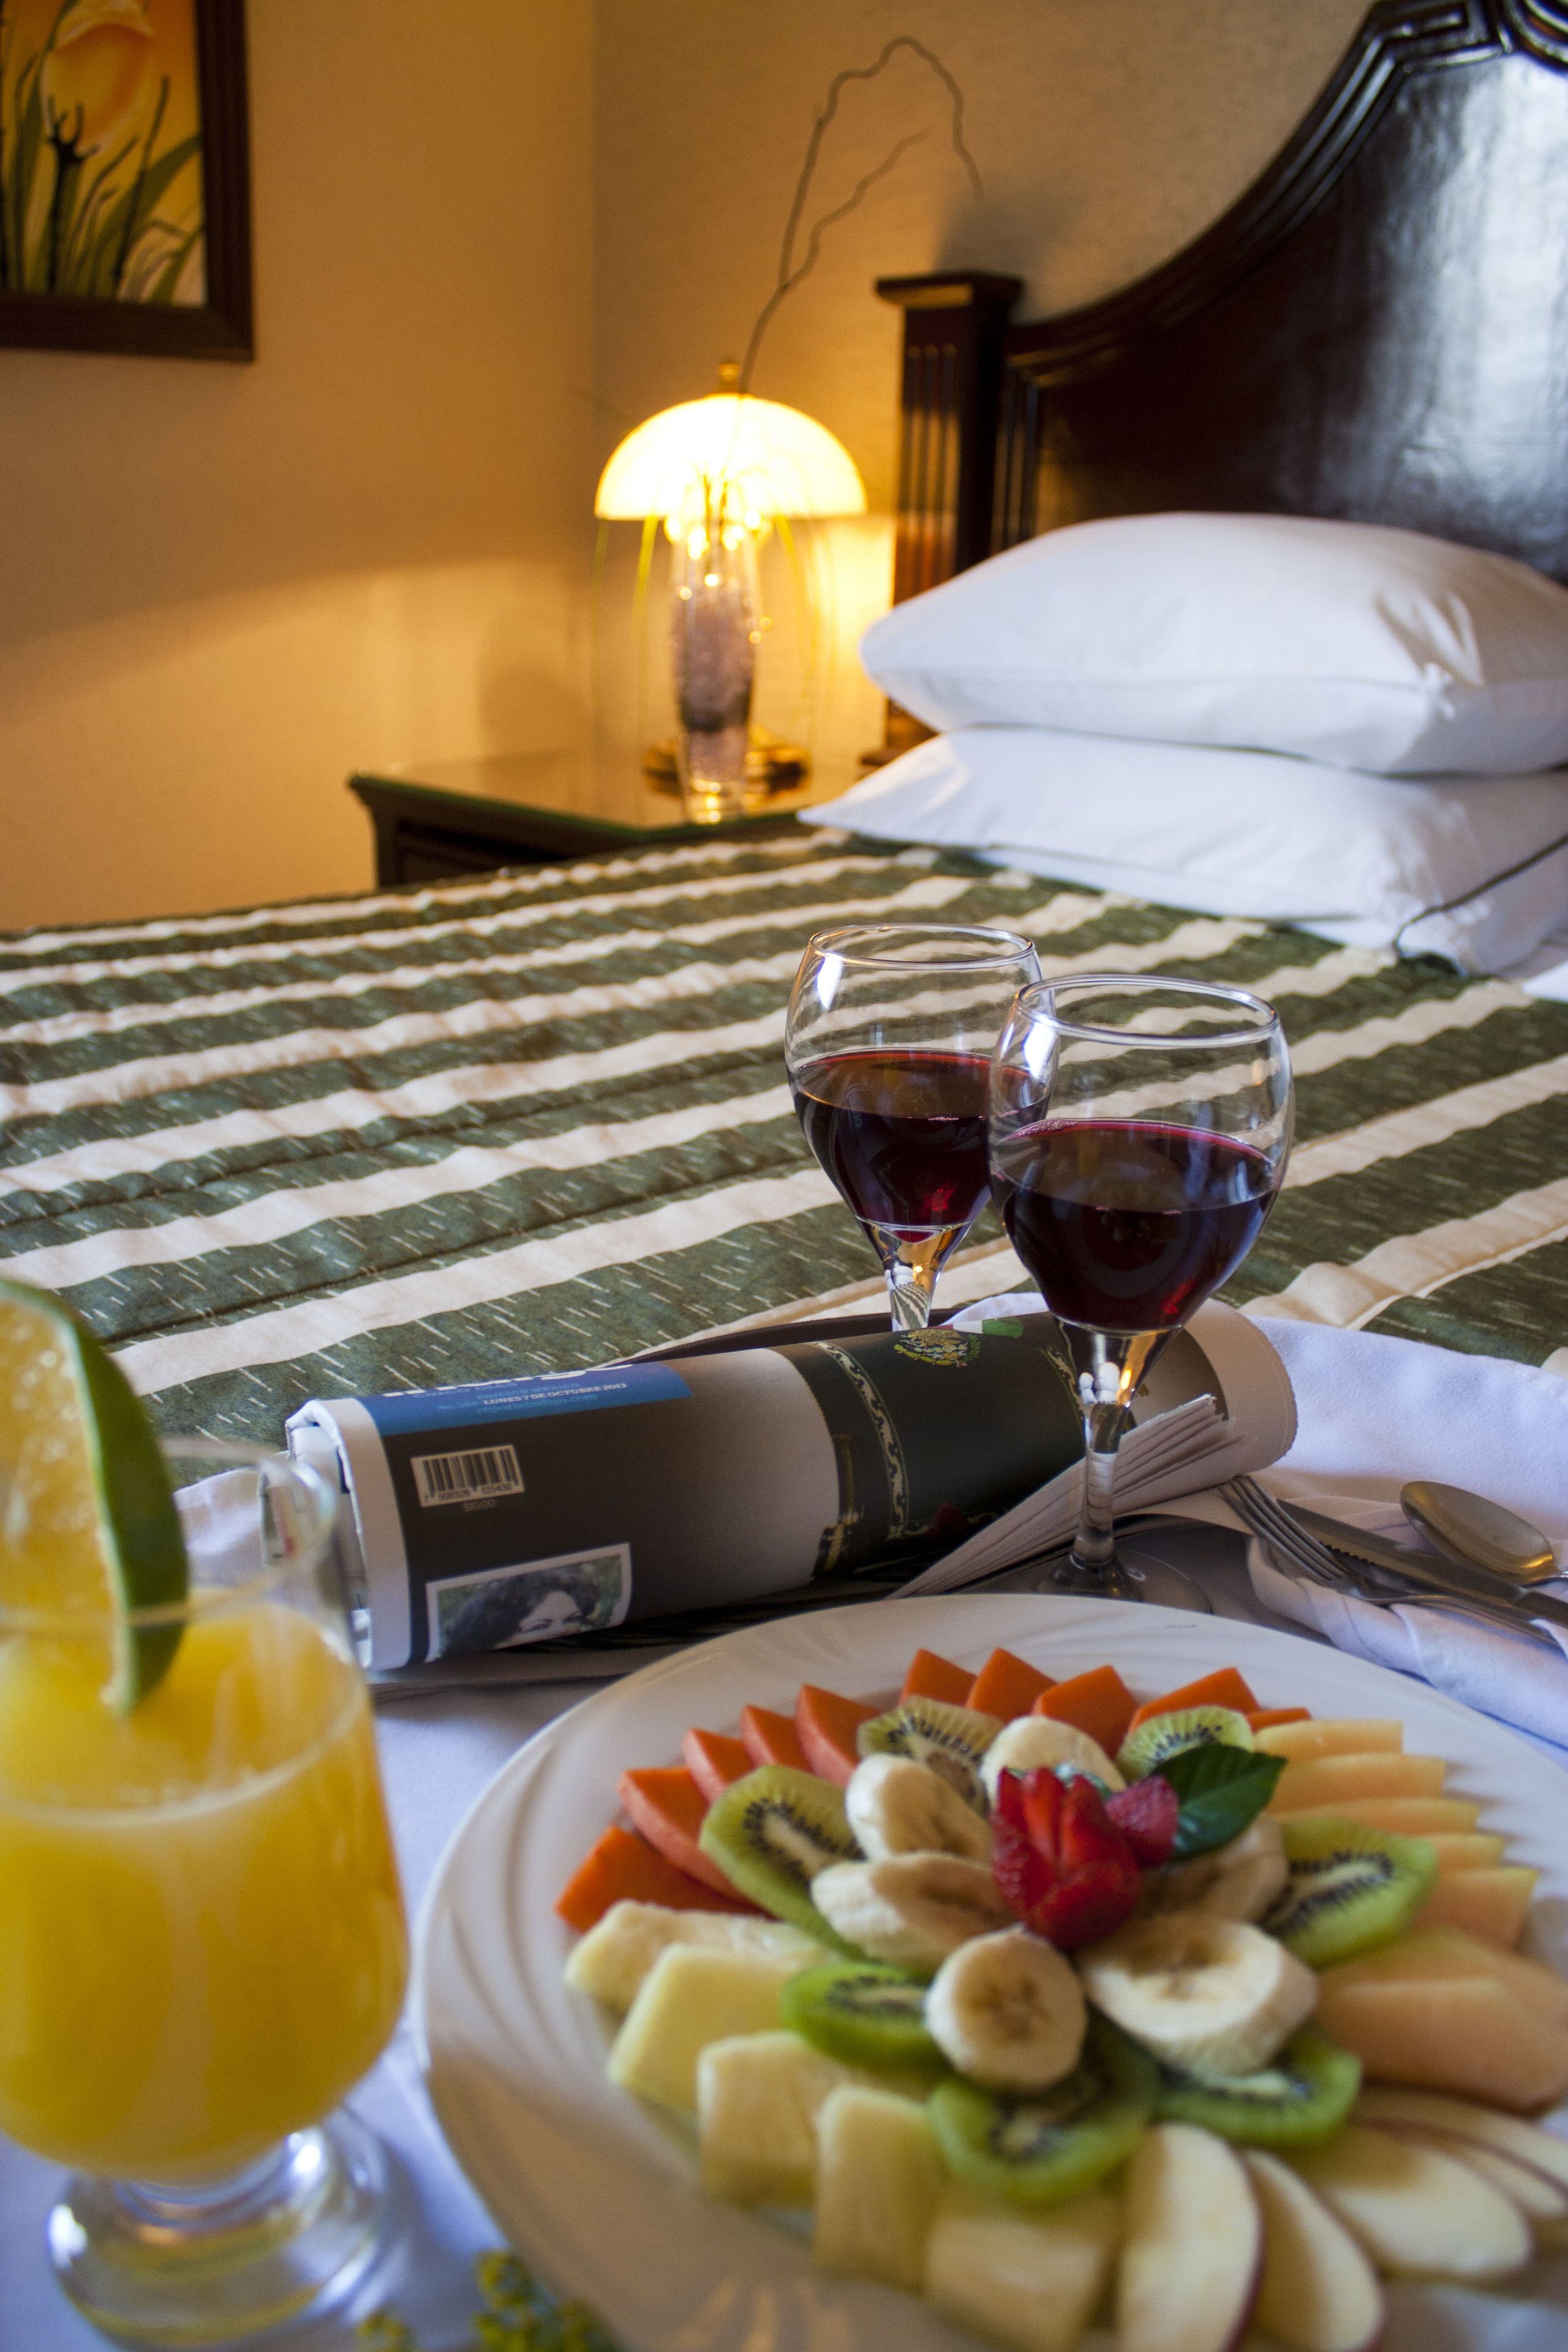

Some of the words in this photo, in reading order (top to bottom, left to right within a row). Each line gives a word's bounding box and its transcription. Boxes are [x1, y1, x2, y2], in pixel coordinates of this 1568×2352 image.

[483, 1396, 522, 1406] LUNES
[547, 1386, 603, 1398] OCTUBRE
[603, 1382, 628, 1392] 2013
